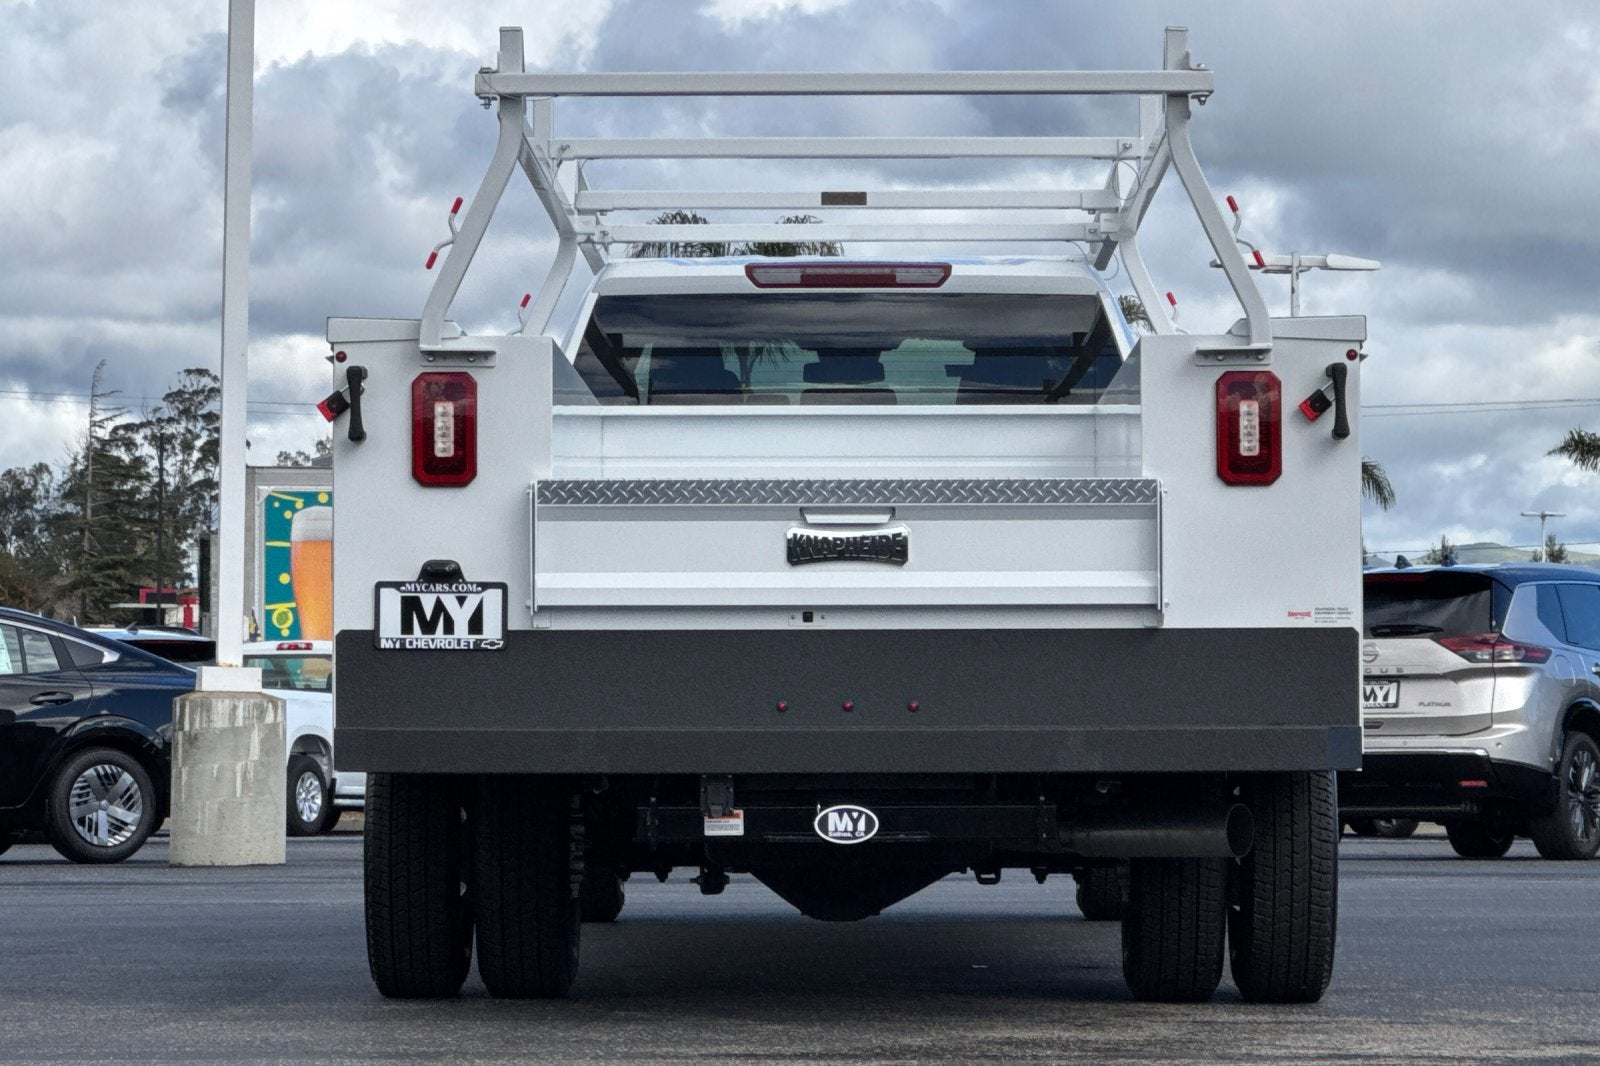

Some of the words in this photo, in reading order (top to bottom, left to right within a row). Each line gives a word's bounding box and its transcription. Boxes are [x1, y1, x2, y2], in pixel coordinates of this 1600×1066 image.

[405, 583, 477, 593] MYCARS.COM
[400, 595, 484, 636] MY
[380, 638, 400, 649] MY
[405, 638, 476, 649] CHEVROLET
[828, 812, 866, 831] MY
